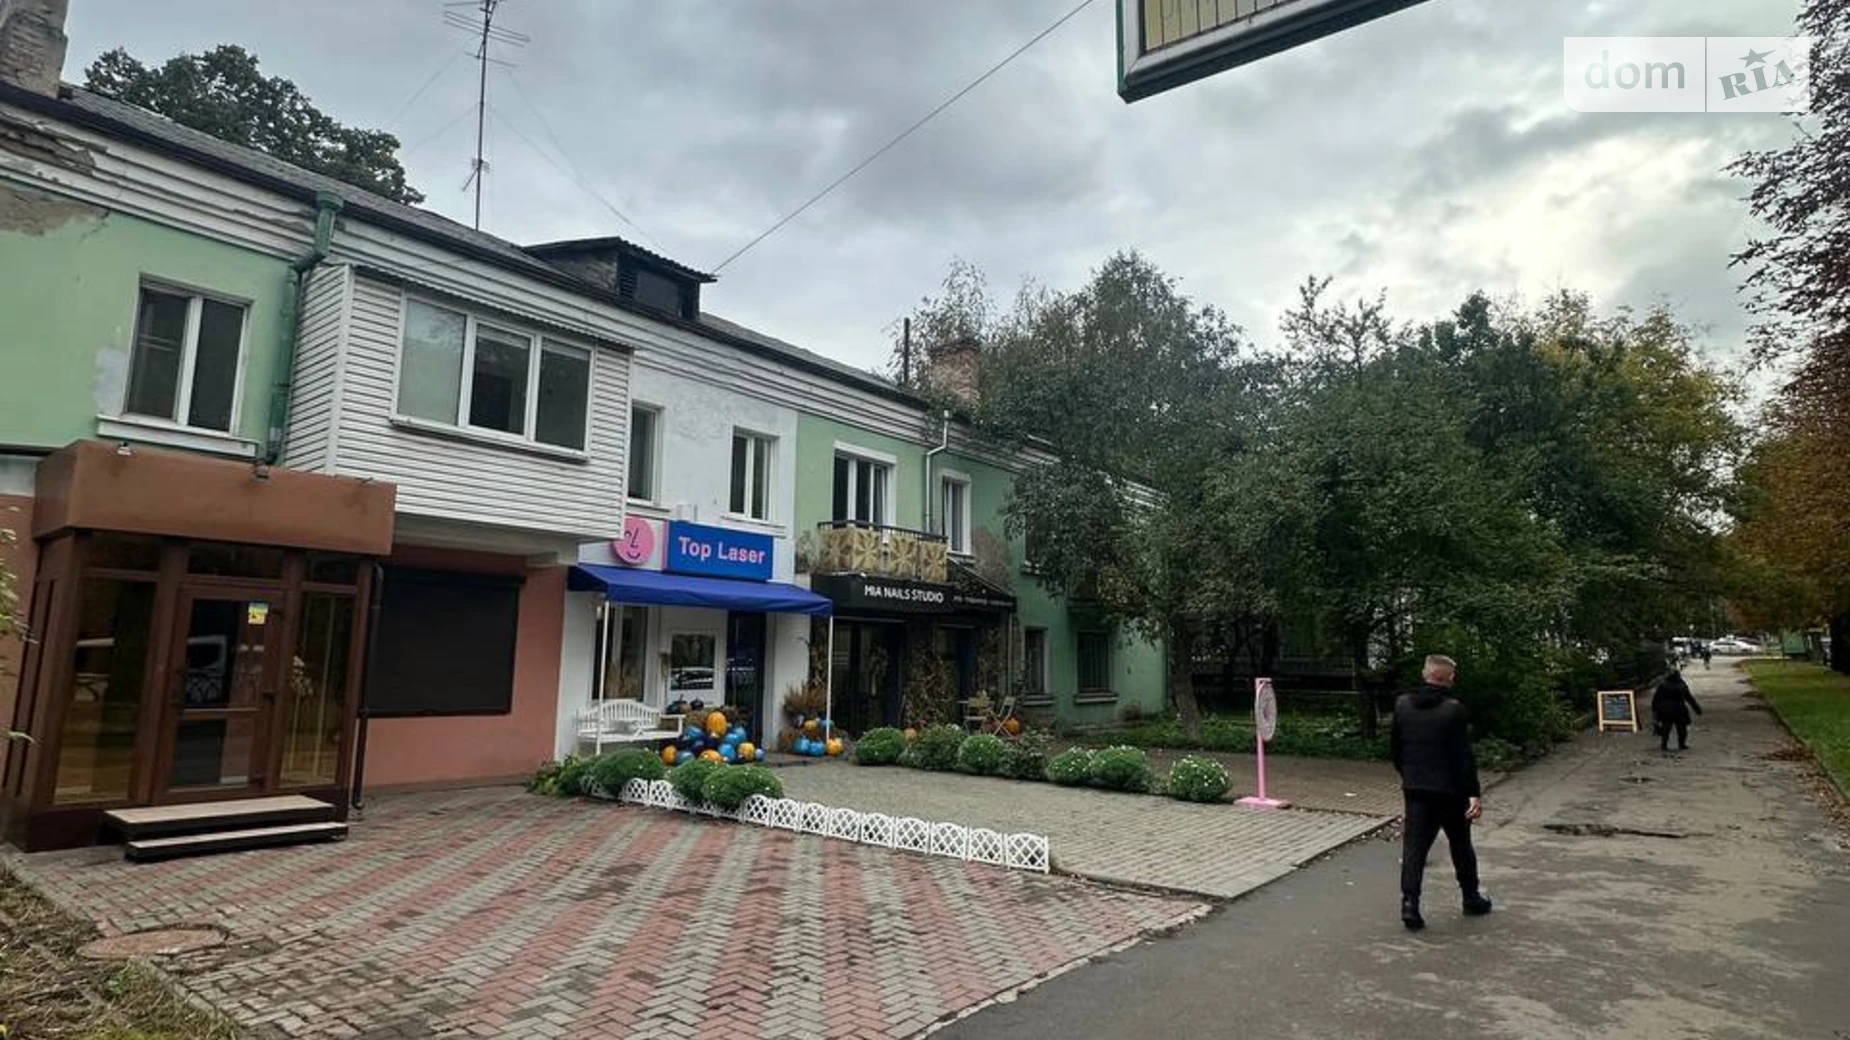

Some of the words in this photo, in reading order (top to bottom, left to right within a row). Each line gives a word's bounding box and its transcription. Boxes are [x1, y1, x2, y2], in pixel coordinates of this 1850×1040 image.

[678, 536, 711, 562] Top
[718, 541, 766, 564] Laser
[864, 585, 883, 597] MIA
[884, 586, 910, 600] NAILS
[911, 589, 944, 604] STUDIO
